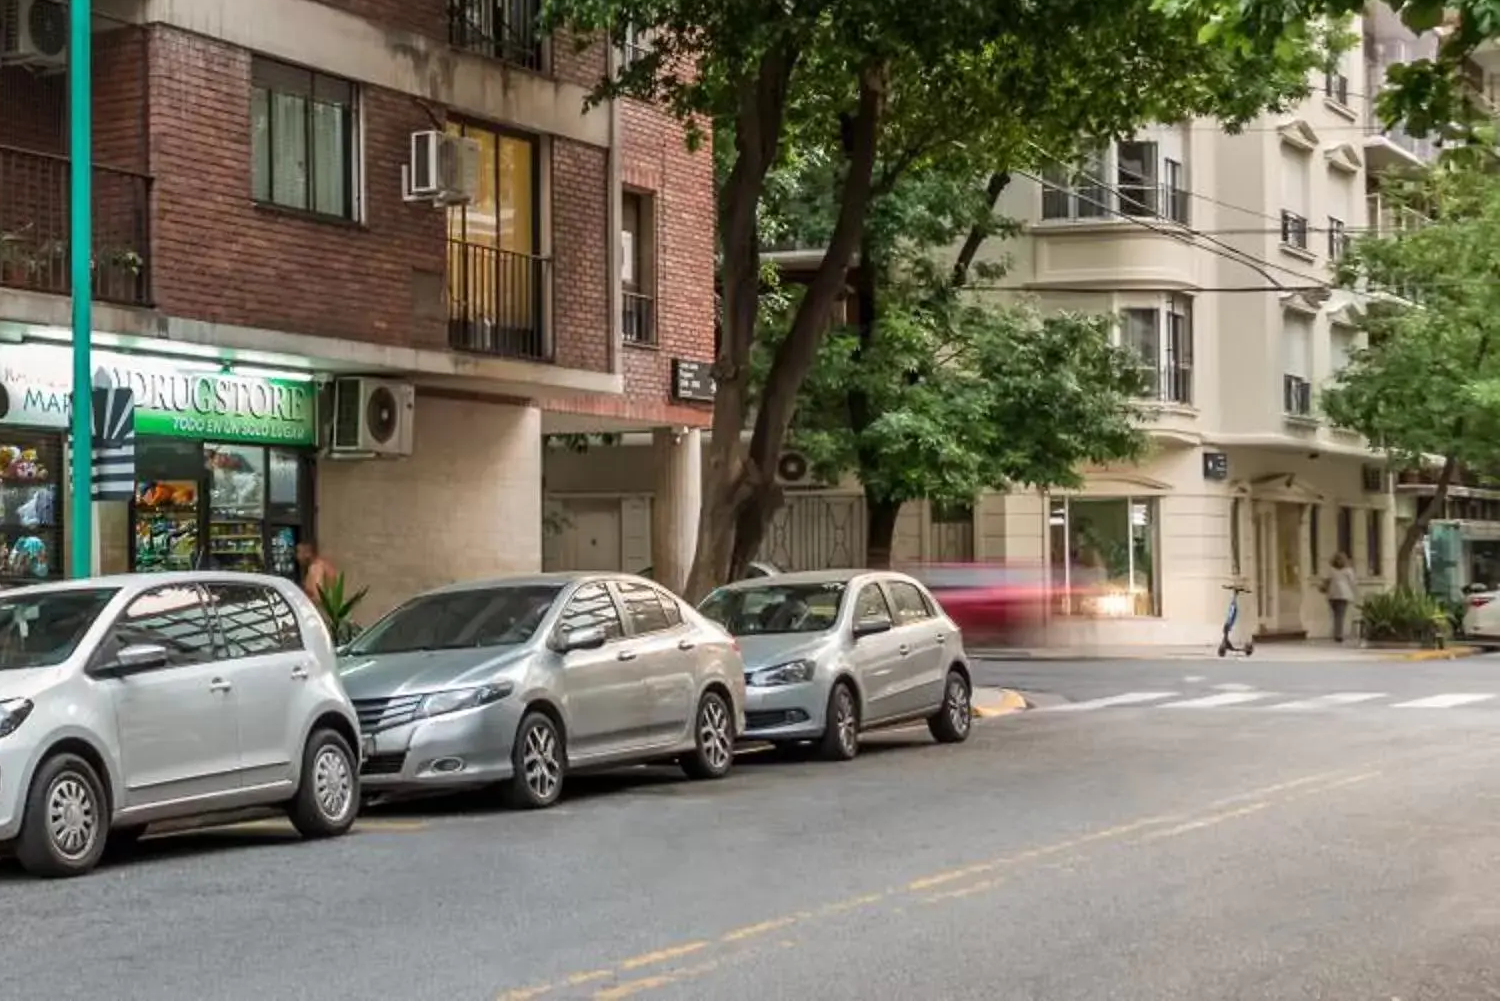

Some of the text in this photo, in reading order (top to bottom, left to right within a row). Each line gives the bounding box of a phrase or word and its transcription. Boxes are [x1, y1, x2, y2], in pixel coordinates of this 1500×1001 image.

[172, 417, 204, 432] TODO
[207, 420, 221, 434] EN
[241, 423, 268, 437] SOLO
[271, 425, 305, 440] LUGAR
